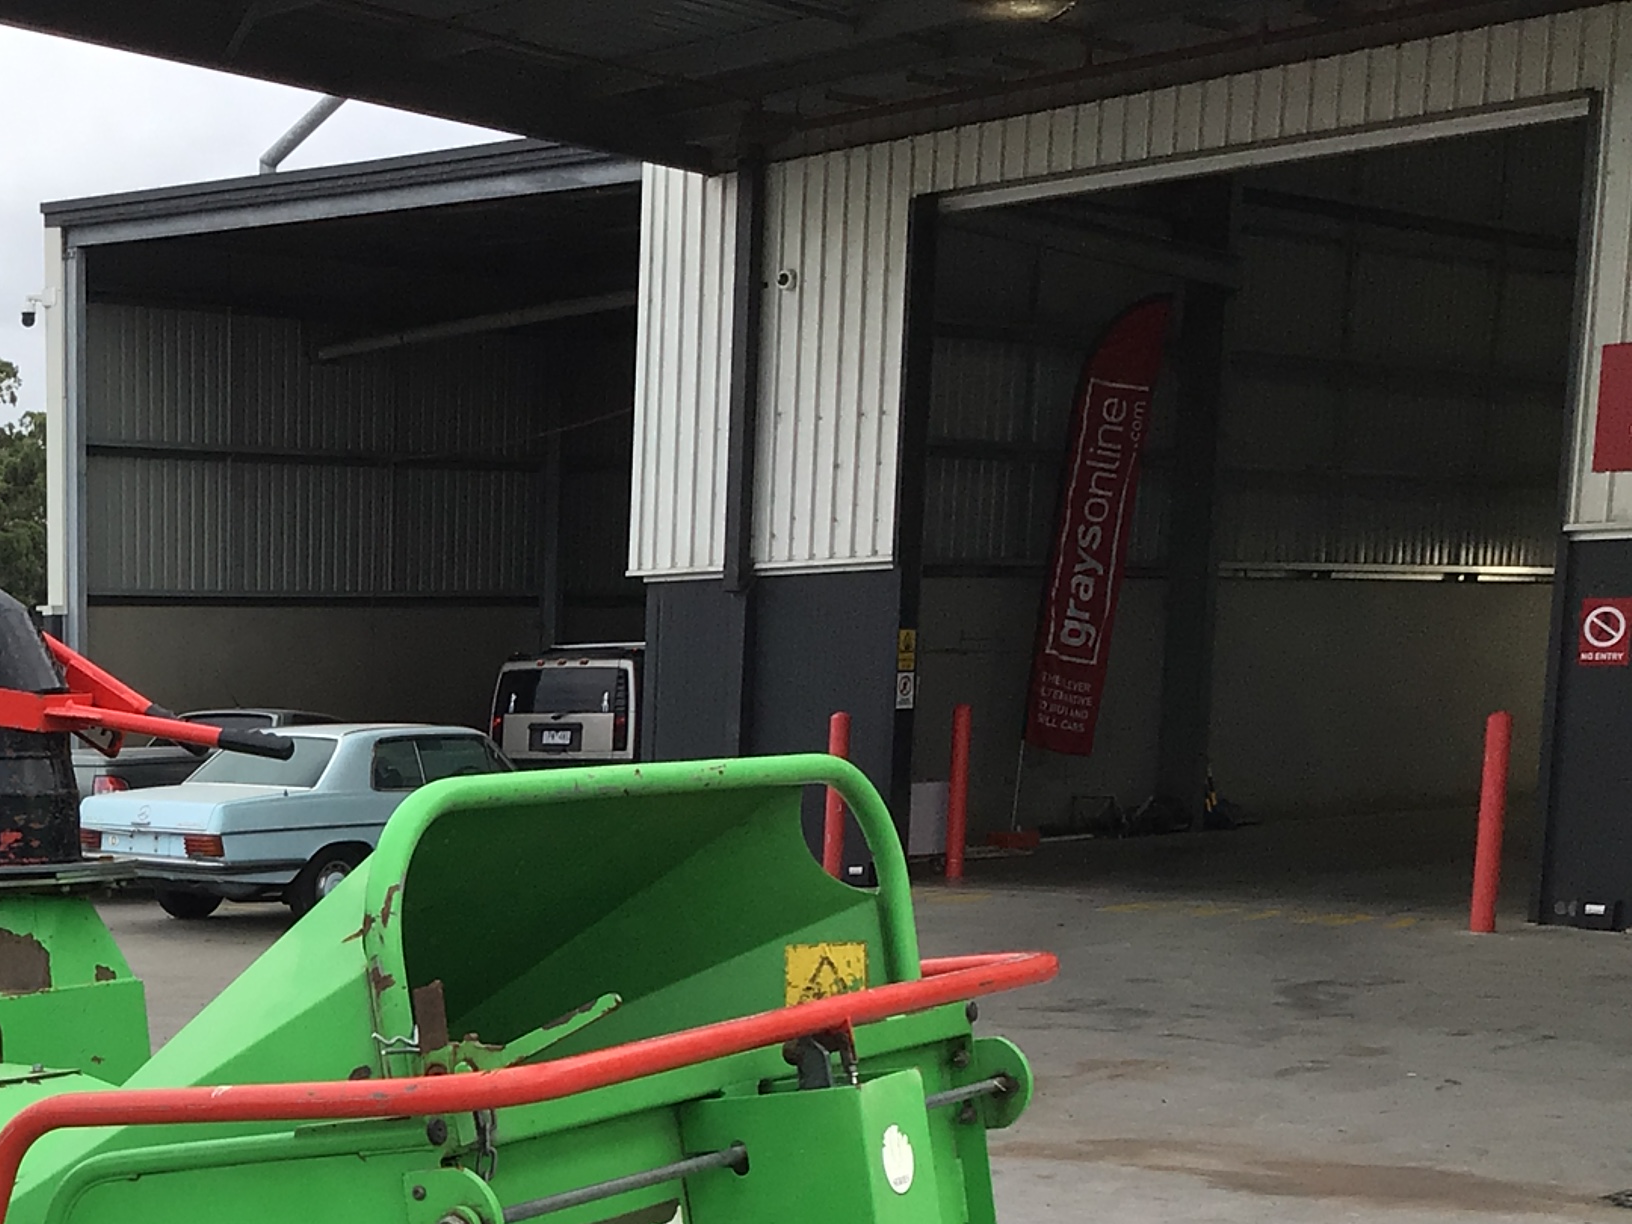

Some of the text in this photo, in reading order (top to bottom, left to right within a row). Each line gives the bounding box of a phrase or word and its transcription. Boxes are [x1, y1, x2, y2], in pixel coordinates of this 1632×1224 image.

[1059, 398, 1128, 648] graysonline
[1580, 652, 1624, 661] NO ENTRY
